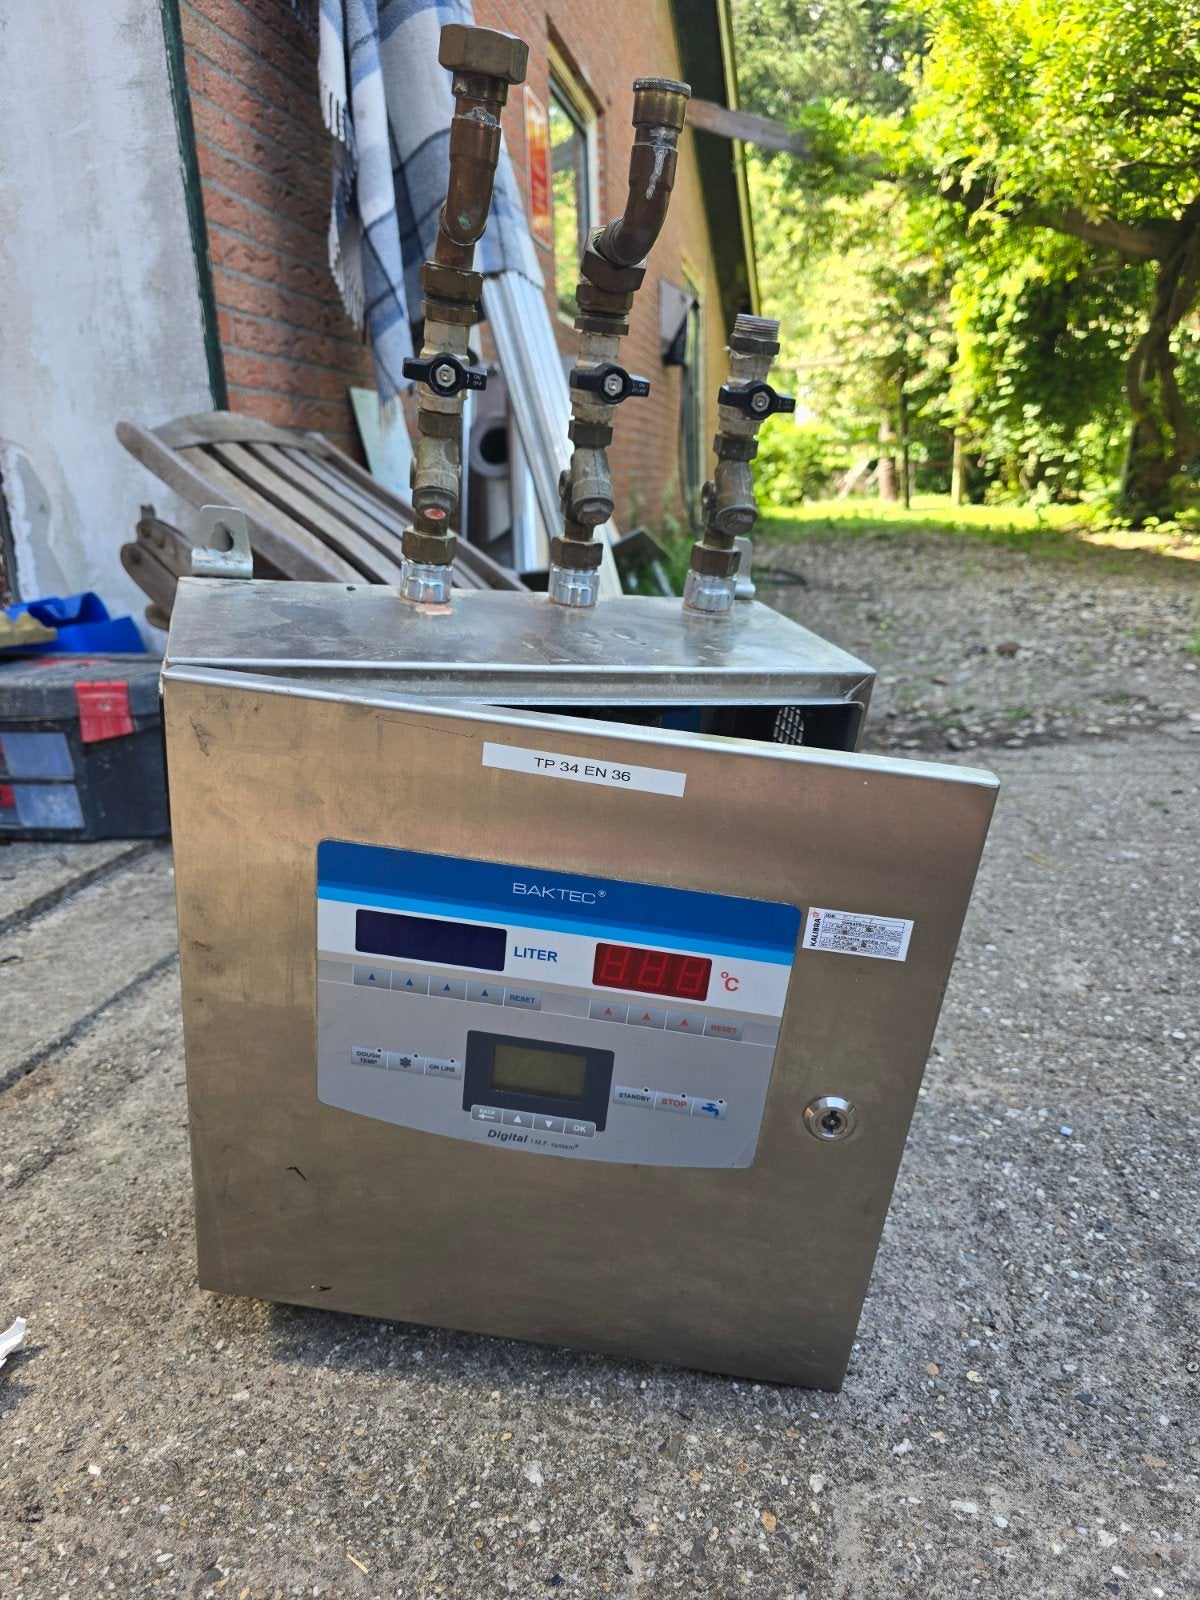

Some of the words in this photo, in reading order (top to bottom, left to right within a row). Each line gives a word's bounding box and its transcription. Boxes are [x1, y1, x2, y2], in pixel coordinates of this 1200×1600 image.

[534, 757, 555, 769] TP
[559, 761, 578, 773] 34
[585, 765, 607, 778] EN
[611, 770, 631, 782] 36
[810, 918, 821, 946] KALIBRA
[514, 946, 558, 962] LITER
[509, 994, 535, 1004] RESET
[710, 1024, 737, 1034] RESET
[356, 1050, 381, 1059] DOUGH
[360, 1057, 378, 1065] TEMP
[440, 1065, 456, 1073] LINE
[618, 1092, 650, 1102] STANDBY
[661, 1097, 687, 1109] STOP
[573, 1124, 586, 1133] OK
[487, 1129, 529, 1144] Digital
